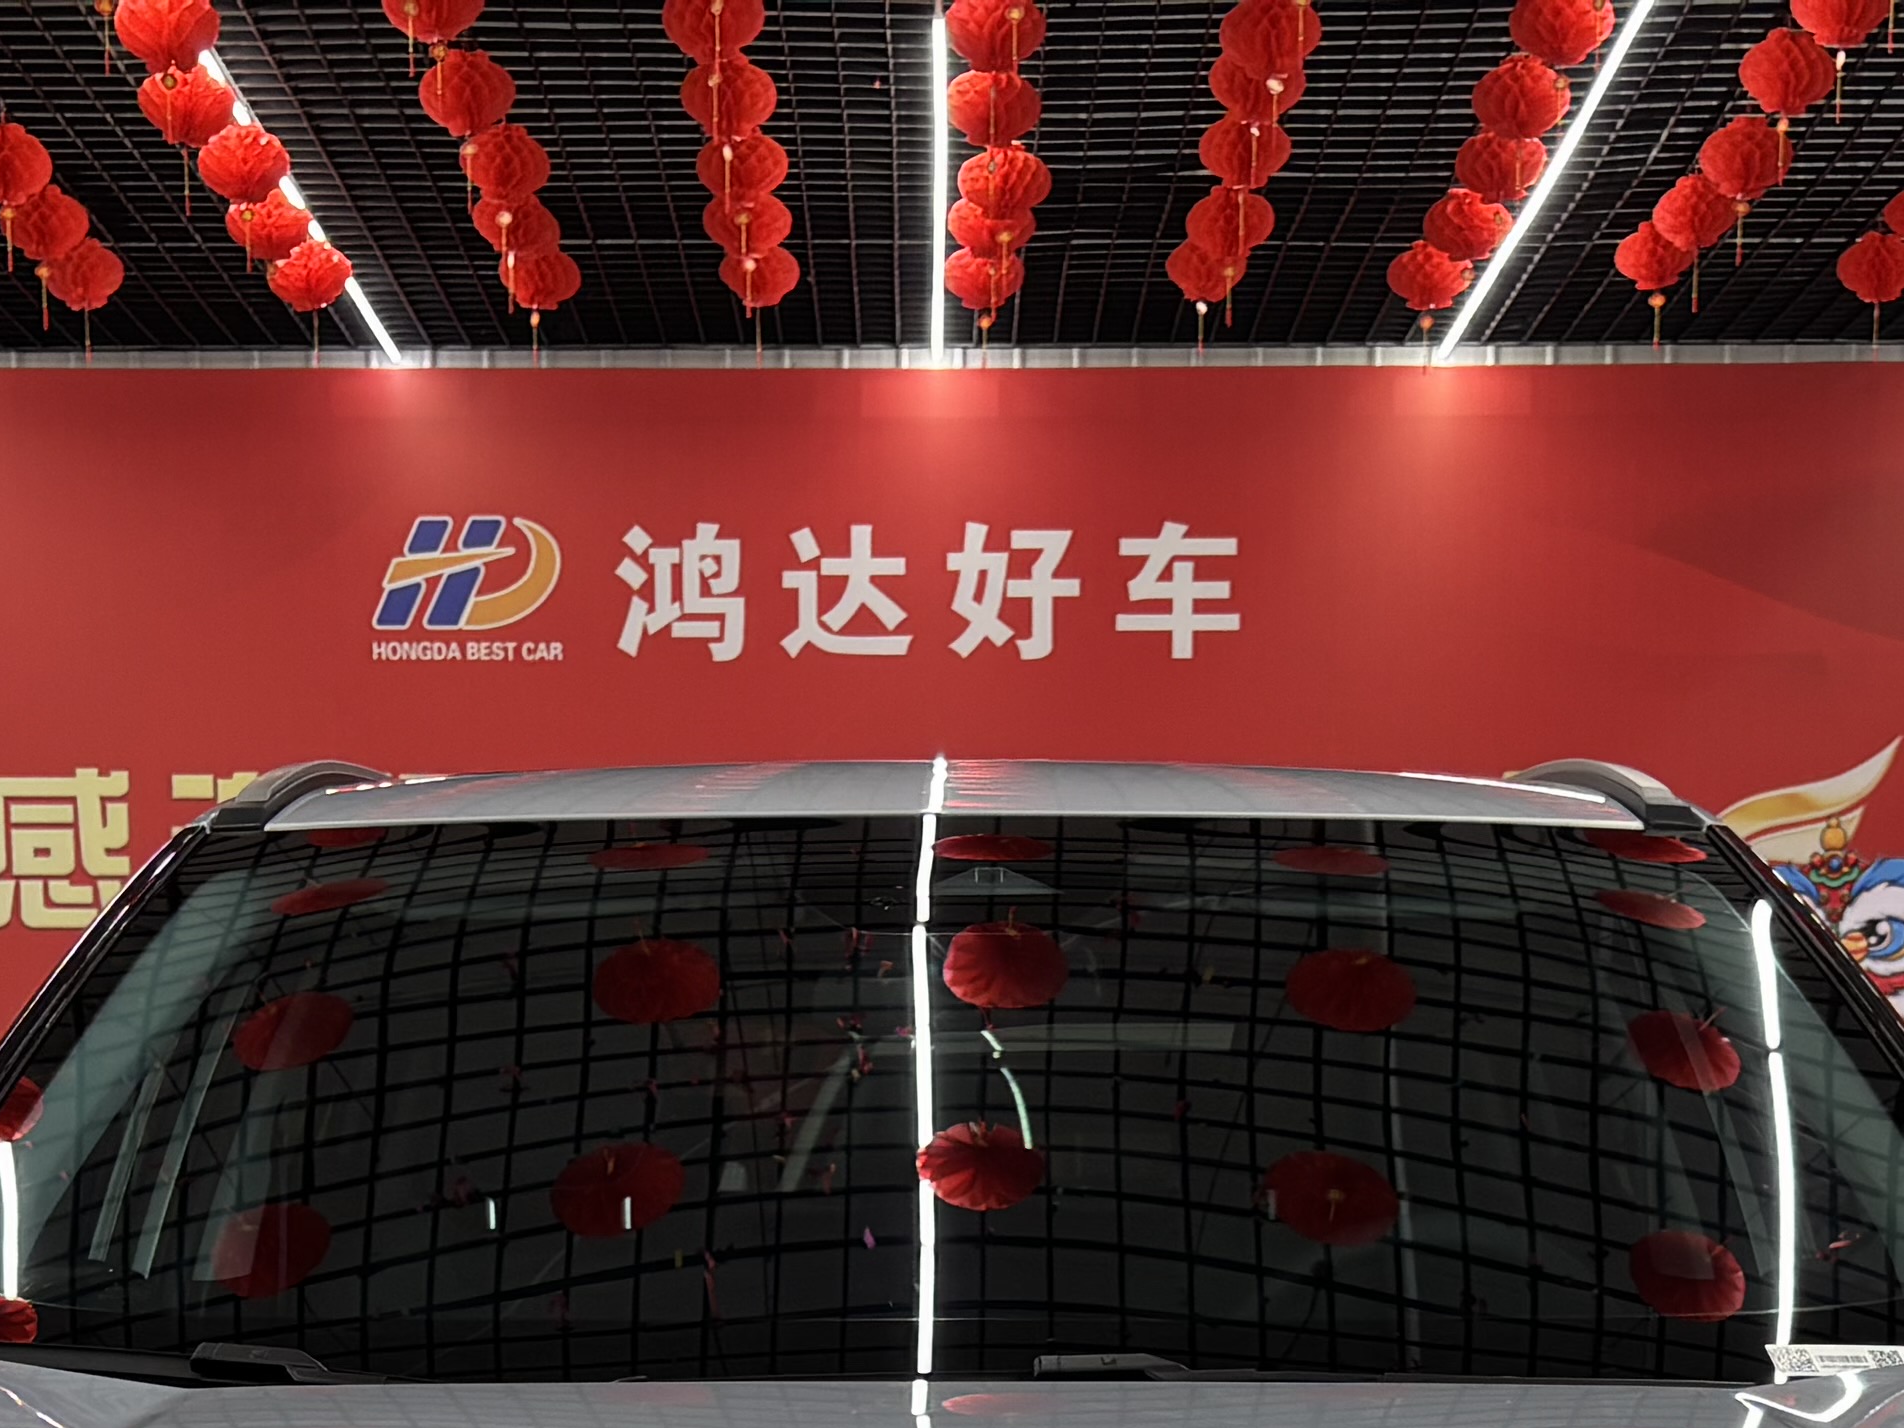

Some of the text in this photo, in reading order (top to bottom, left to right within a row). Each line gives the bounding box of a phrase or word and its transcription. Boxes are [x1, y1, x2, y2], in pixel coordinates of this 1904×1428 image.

[615, 520, 1242, 661] 鸿达好车
[372, 641, 564, 661] HONGDA BEST CAR
